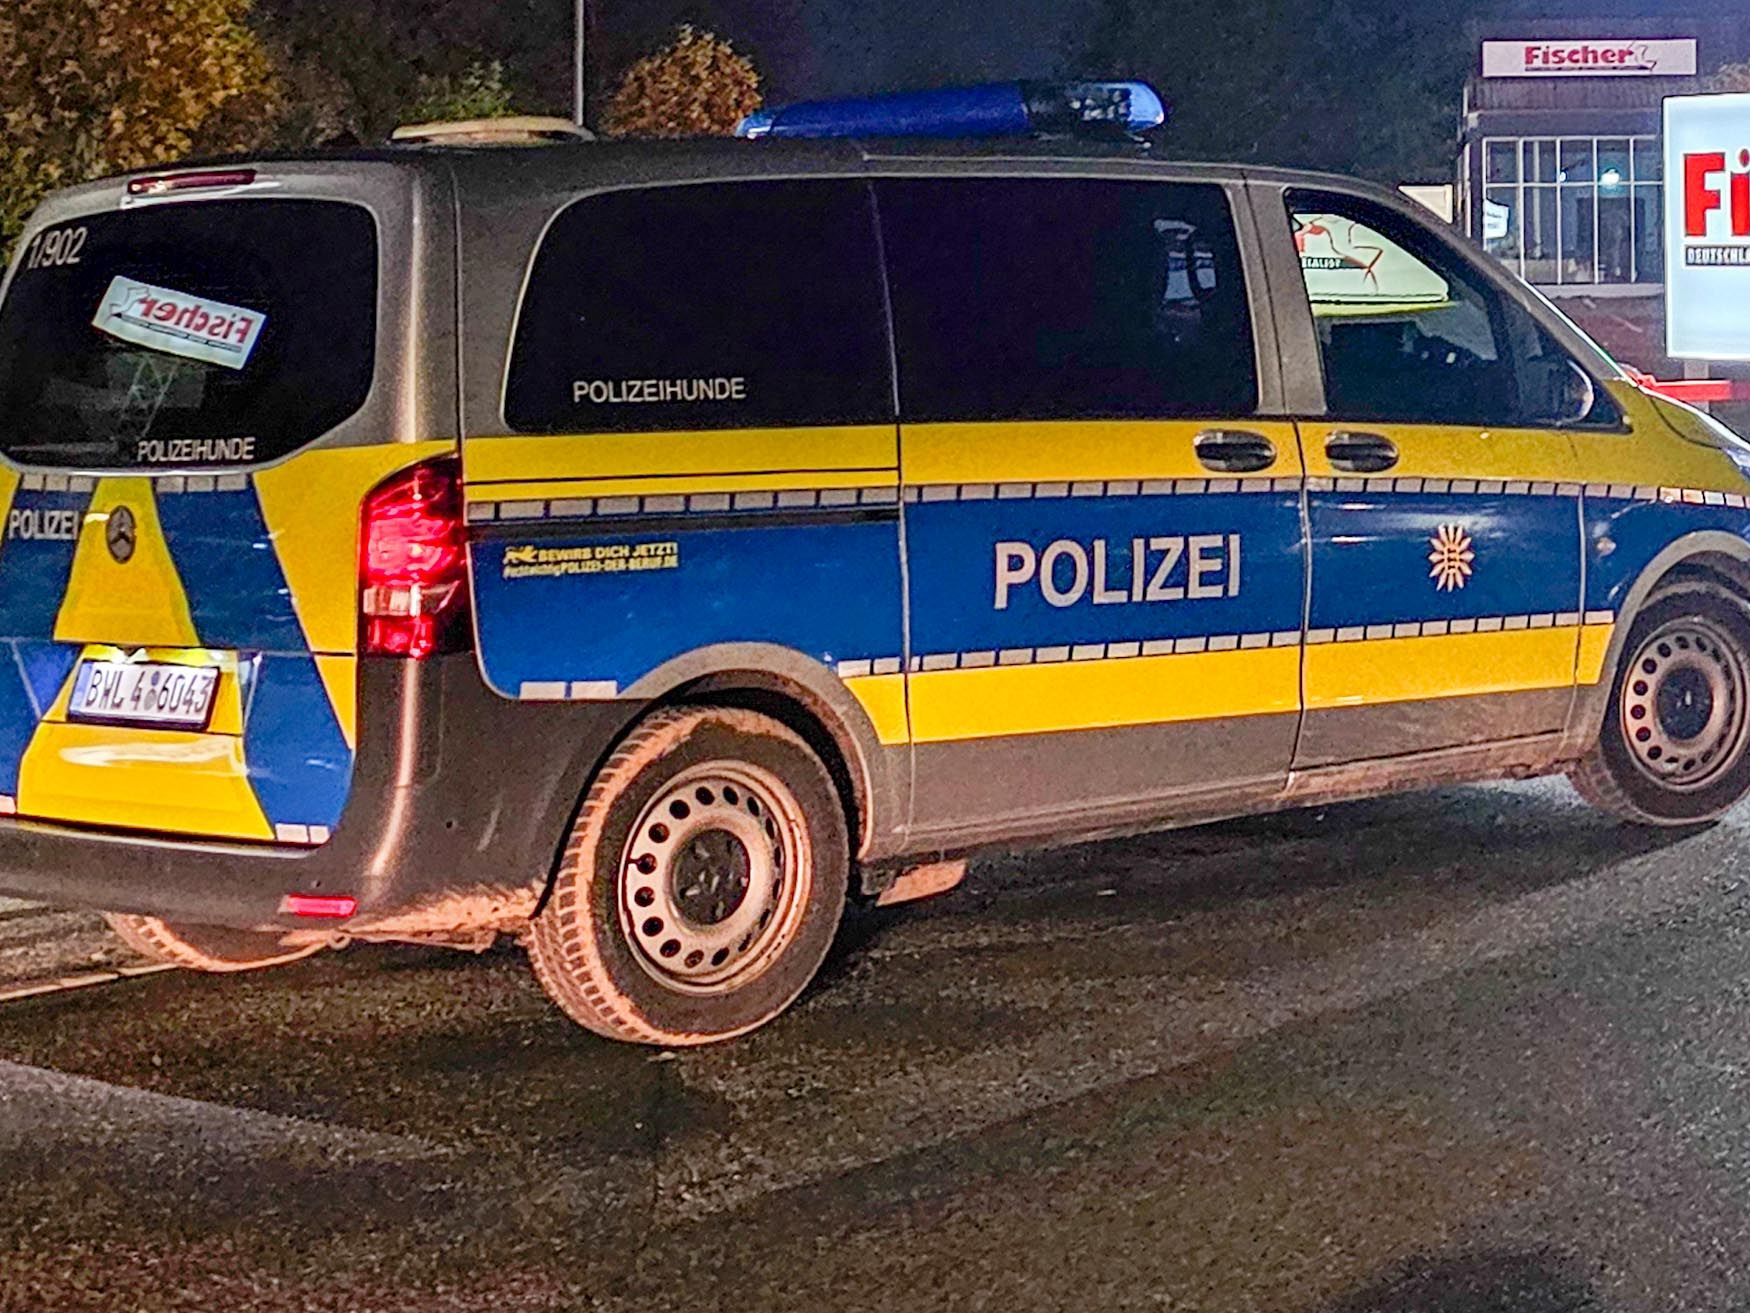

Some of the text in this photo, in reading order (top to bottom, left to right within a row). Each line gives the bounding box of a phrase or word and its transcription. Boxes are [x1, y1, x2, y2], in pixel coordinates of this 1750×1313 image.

[1524, 45, 1634, 65] Fischer
[572, 376, 747, 403] POLIZEIHUNDE
[136, 436, 256, 462] POLIZEIHUNDE
[8, 508, 80, 540] POLIZEI
[538, 541, 678, 562] BEWIRB DICH JETZT!
[993, 533, 1241, 610] POLIZEI
